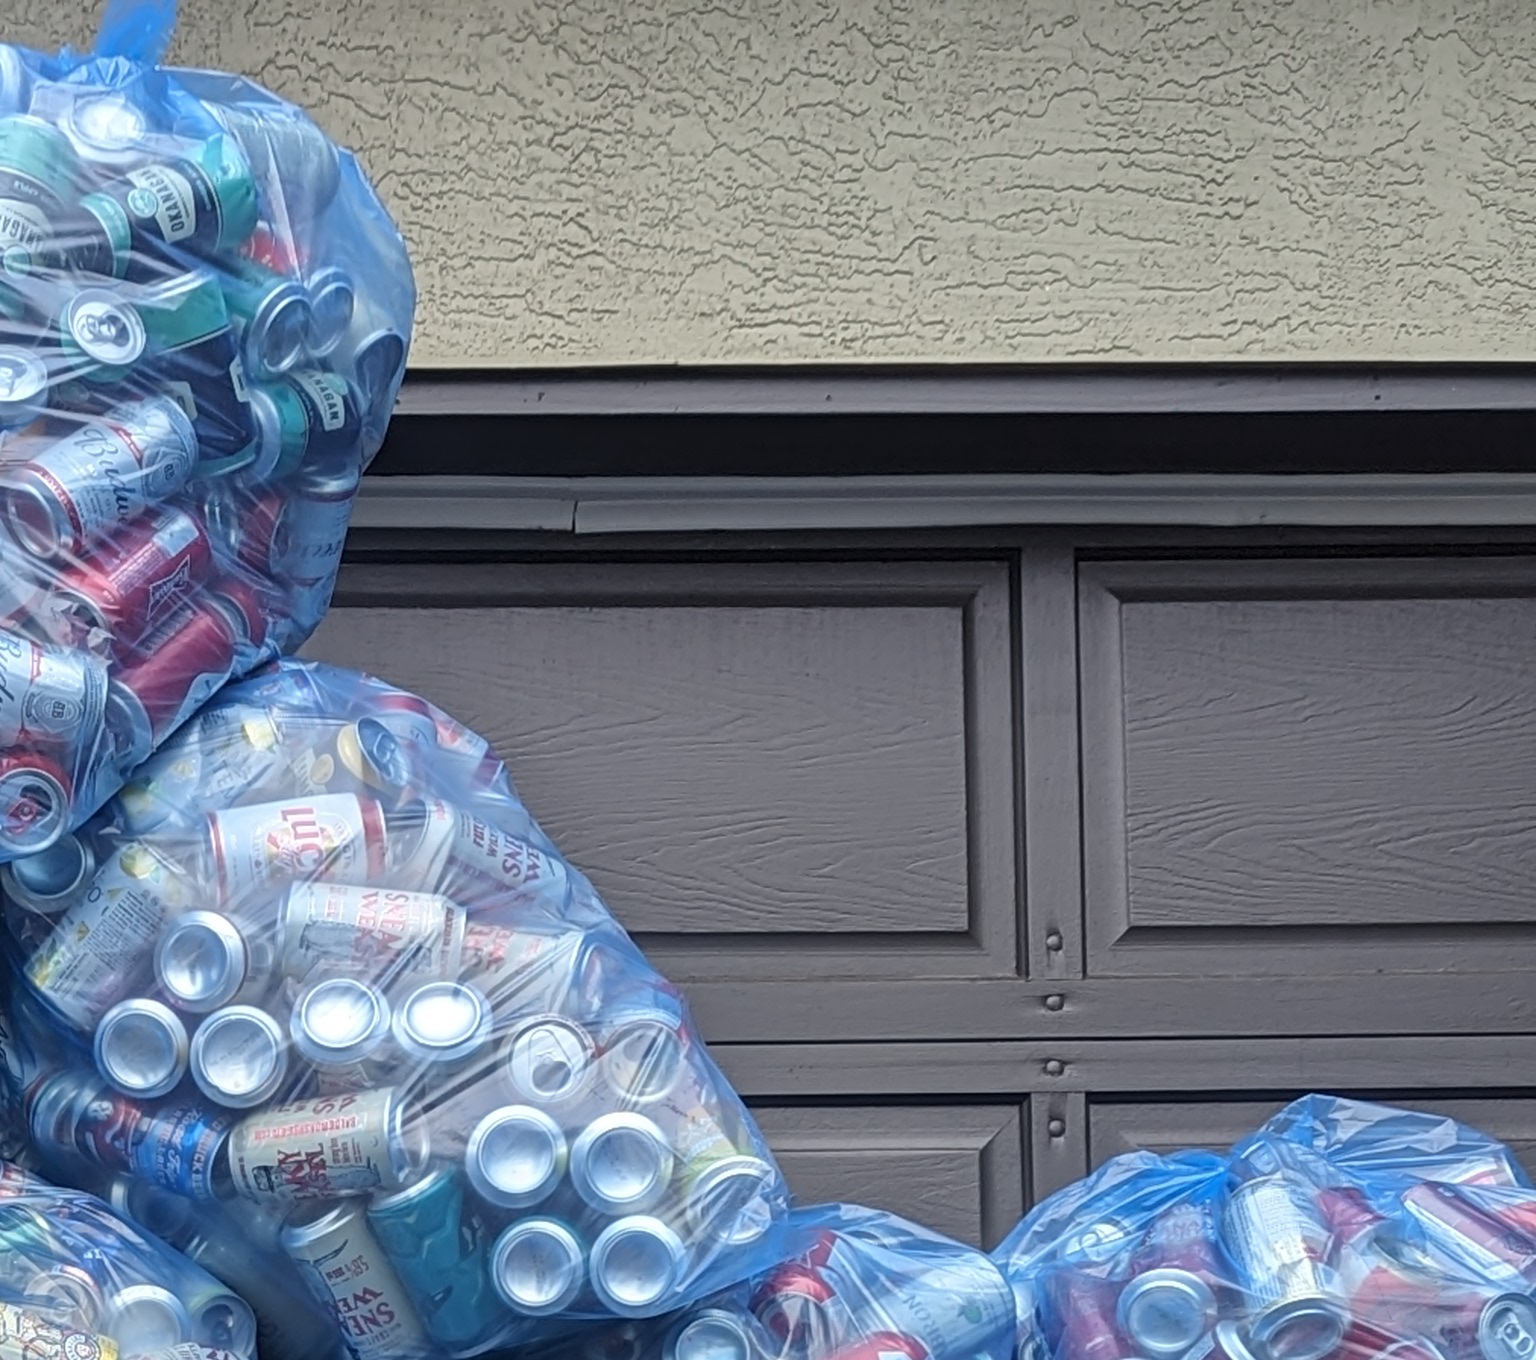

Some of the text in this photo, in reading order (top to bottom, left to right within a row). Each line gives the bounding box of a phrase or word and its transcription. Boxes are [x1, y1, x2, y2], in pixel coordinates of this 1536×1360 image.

[138, 168, 184, 231] OKANAGAN
[383, 892, 409, 953] SNEA
[335, 1294, 397, 1347] SNEA
